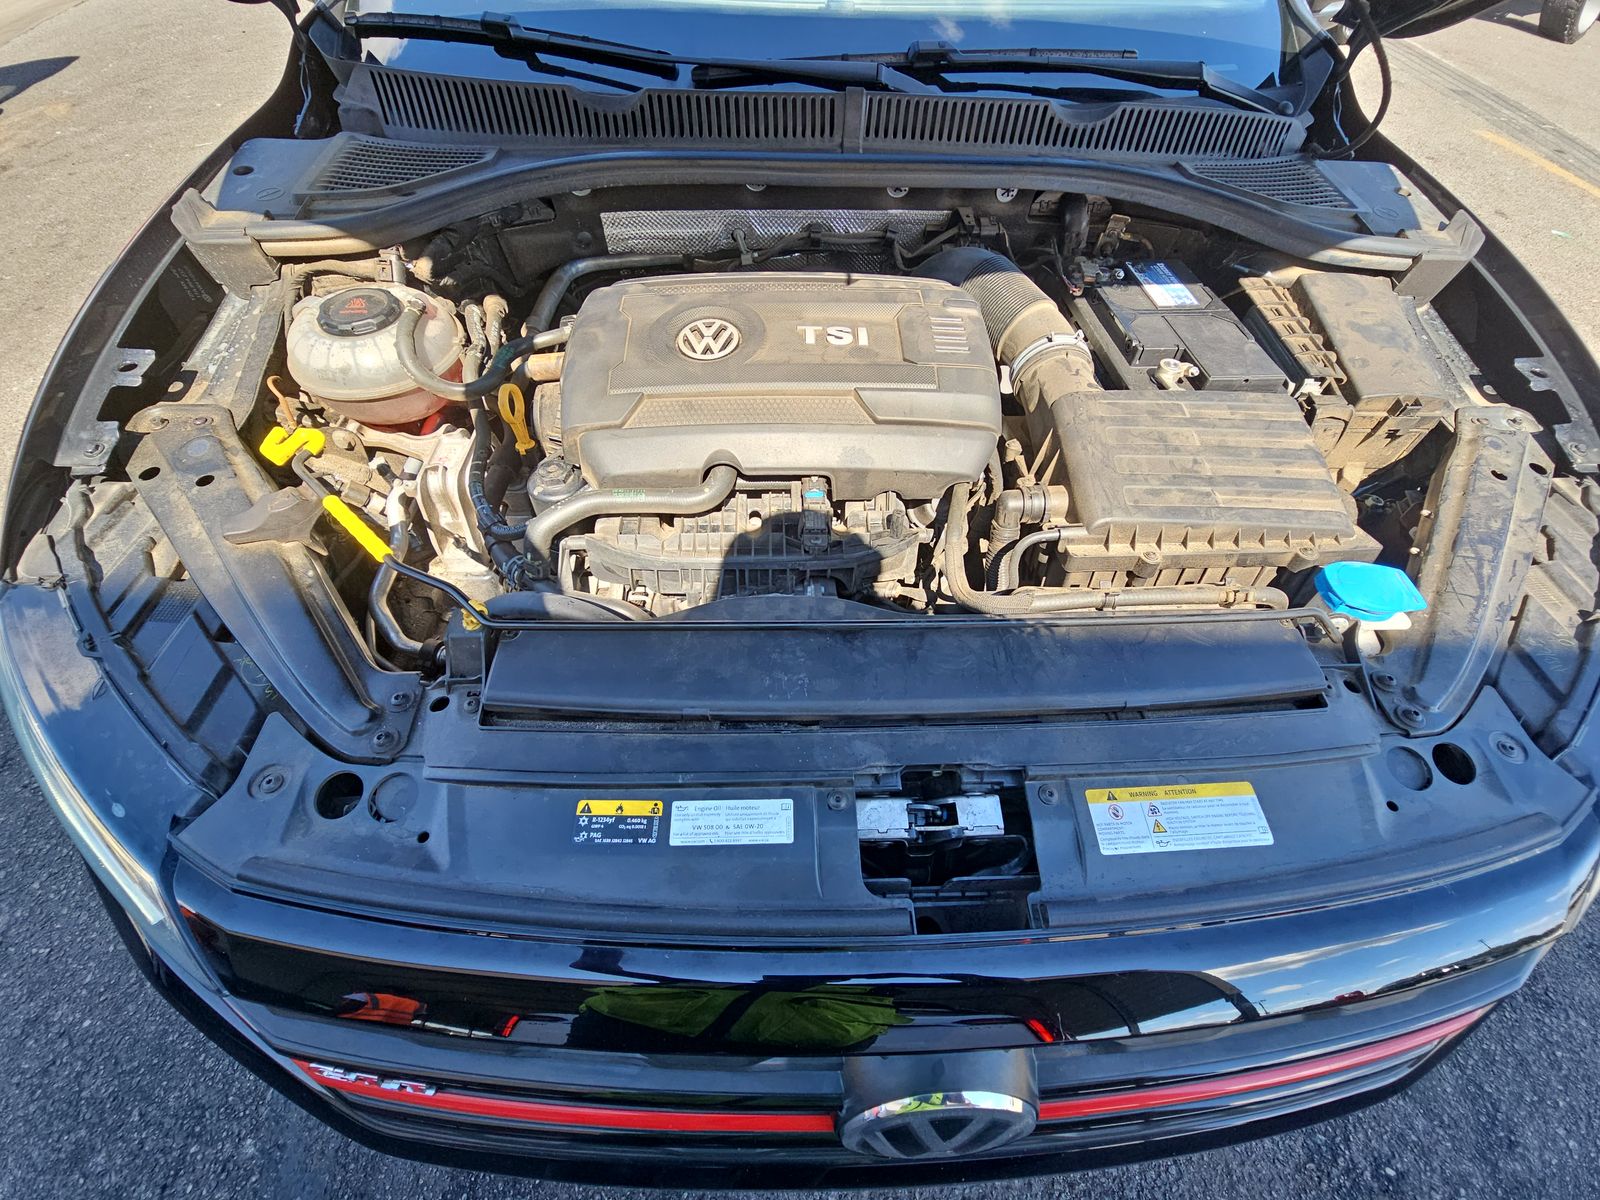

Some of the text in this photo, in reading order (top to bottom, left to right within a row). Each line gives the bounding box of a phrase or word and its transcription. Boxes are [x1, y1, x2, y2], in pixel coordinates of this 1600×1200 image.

[797, 325, 870, 346] TSI
[1128, 788, 1197, 798] WARNING ATTENTION
[592, 817, 616, 825] R-1234yf
